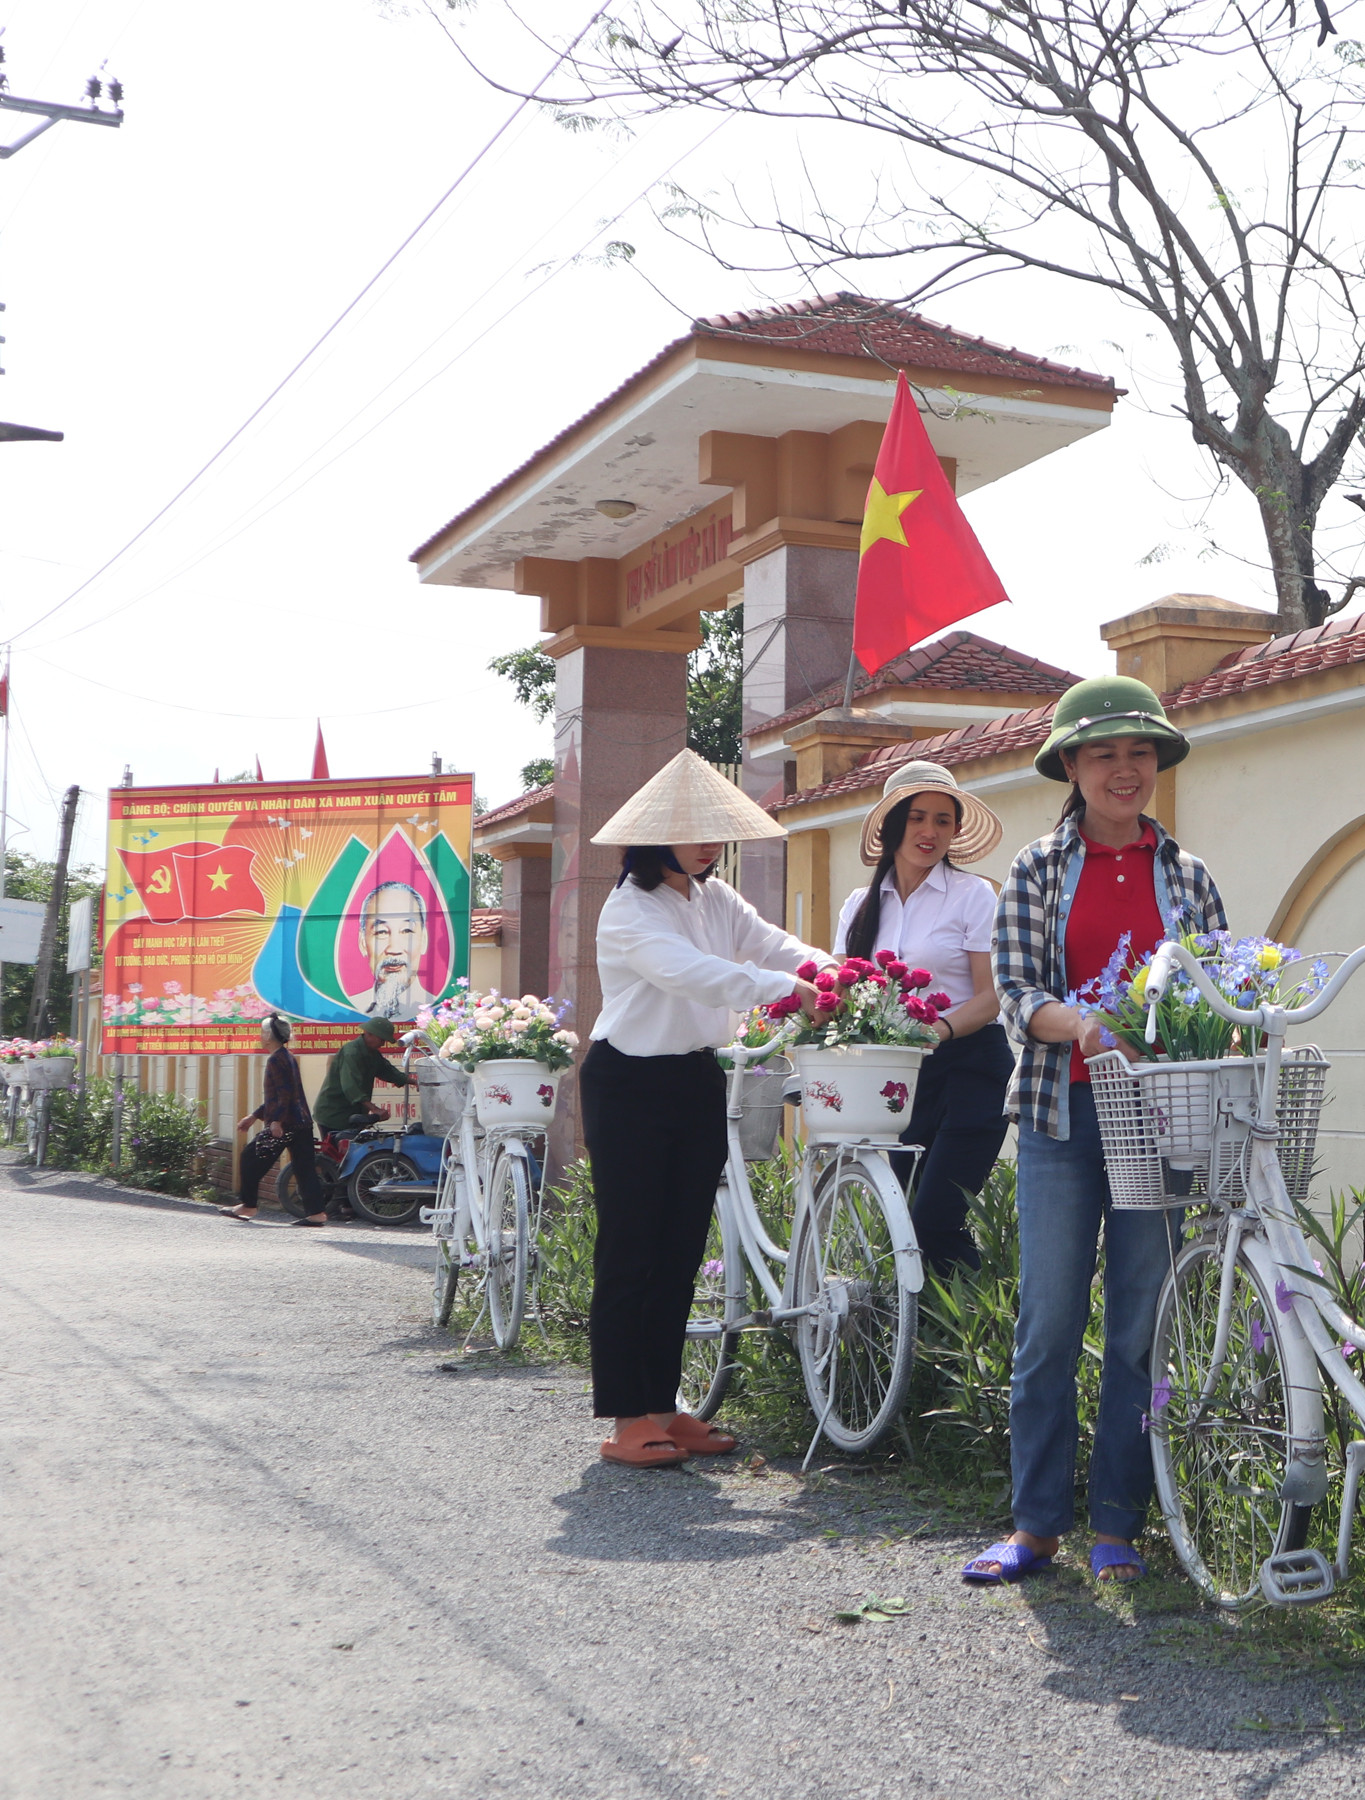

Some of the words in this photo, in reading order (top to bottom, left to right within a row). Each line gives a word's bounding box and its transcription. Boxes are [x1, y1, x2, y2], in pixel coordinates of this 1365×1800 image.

[627, 564, 643, 613] TRỤ
[644, 540, 657, 600] SỞ
[658, 542, 678, 593] LÀM
[680, 526, 700, 584] VIỆC
[122, 803, 150, 815] ĐẢNG
[154, 803, 170, 816] BỘ;
[173, 801, 204, 813] CHÍNH
[244, 799, 258, 811] VÀ
[261, 798, 290, 810] NHÂN
[294, 796, 316, 809] DÂN
[318, 796, 333, 808] XÃ
[336, 796, 361, 807] NAM
[364, 793, 394, 806] XUÂN
[396, 790, 430, 804] QUYẾT
[433, 790, 457, 803] TÂM
[210, 936, 224, 947] THEO
[171, 955, 190, 965] PHONG
[227, 954, 243, 964] MINH
